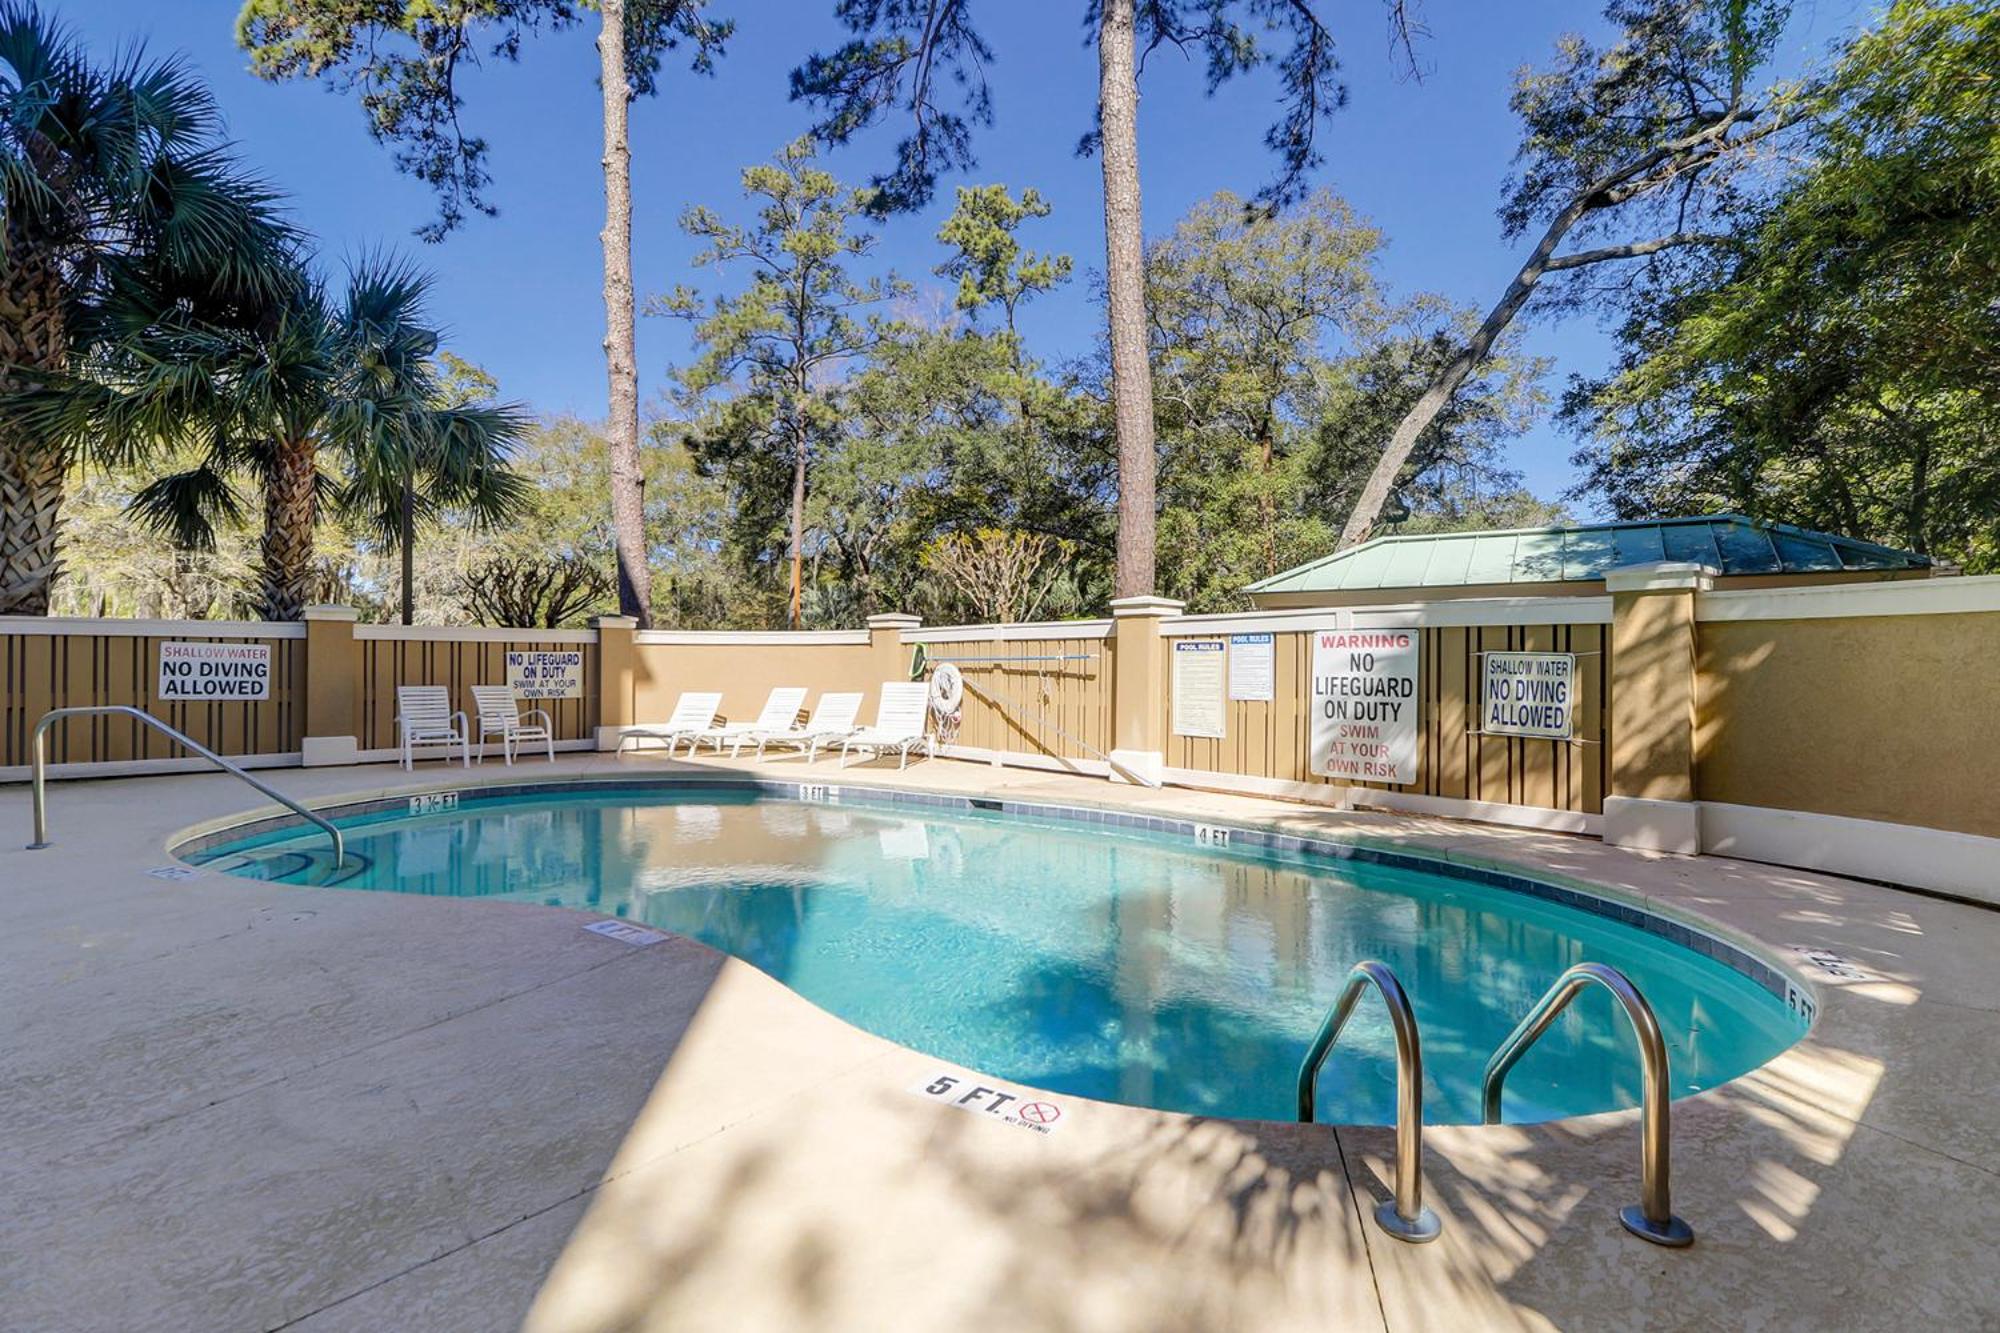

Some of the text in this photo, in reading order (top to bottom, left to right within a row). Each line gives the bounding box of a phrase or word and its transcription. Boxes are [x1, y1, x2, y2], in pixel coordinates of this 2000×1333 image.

[1198, 643, 1220, 651] RULES
[1232, 635, 1248, 643] POOL
[1321, 634, 1409, 649] WARNING
[164, 646, 268, 659] SHALLOW WATER
[509, 653, 580, 666] NO LIFEGUARD
[163, 661, 267, 677] NO DIVING
[1350, 653, 1375, 672] NO
[1490, 659, 1569, 676] SHALLOW WATER
[523, 666, 566, 679] ON DUTY
[165, 680, 264, 695] ALLOWED
[513, 679, 577, 689] SWIM AT YOUR
[1316, 676, 1413, 698] LIFEGUARD
[1490, 679, 1566, 703] NO DIVING
[523, 688, 566, 698] OWN RISK
[1324, 700, 1402, 722] ON DUTY
[1491, 703, 1564, 729] ALLOWED
[1340, 725, 1379, 739] SWIM
[1331, 742, 1389, 758] AT YOUR
[1327, 759, 1397, 777] OWN RISK
[1789, 988, 1797, 1010] 5
[926, 1076, 1016, 1114] 5 FT.
